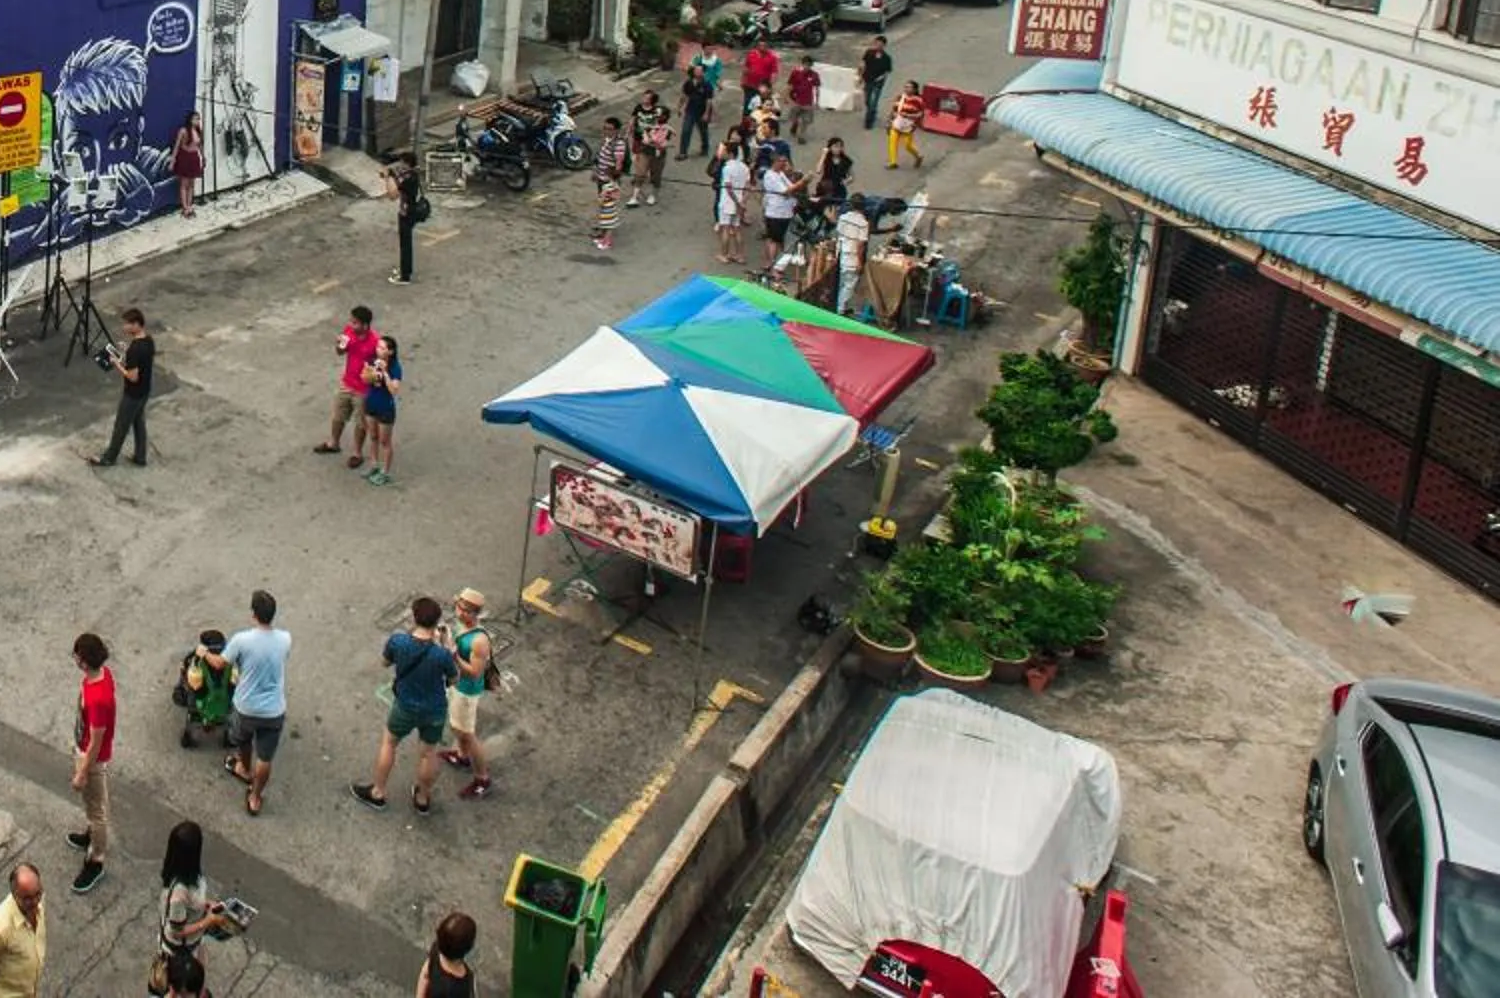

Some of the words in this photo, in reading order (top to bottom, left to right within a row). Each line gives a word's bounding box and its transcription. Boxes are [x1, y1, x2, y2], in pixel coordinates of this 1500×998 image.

[1027, 5, 1097, 33] ZHANG
[1248, 85, 1430, 187] 張貿易
